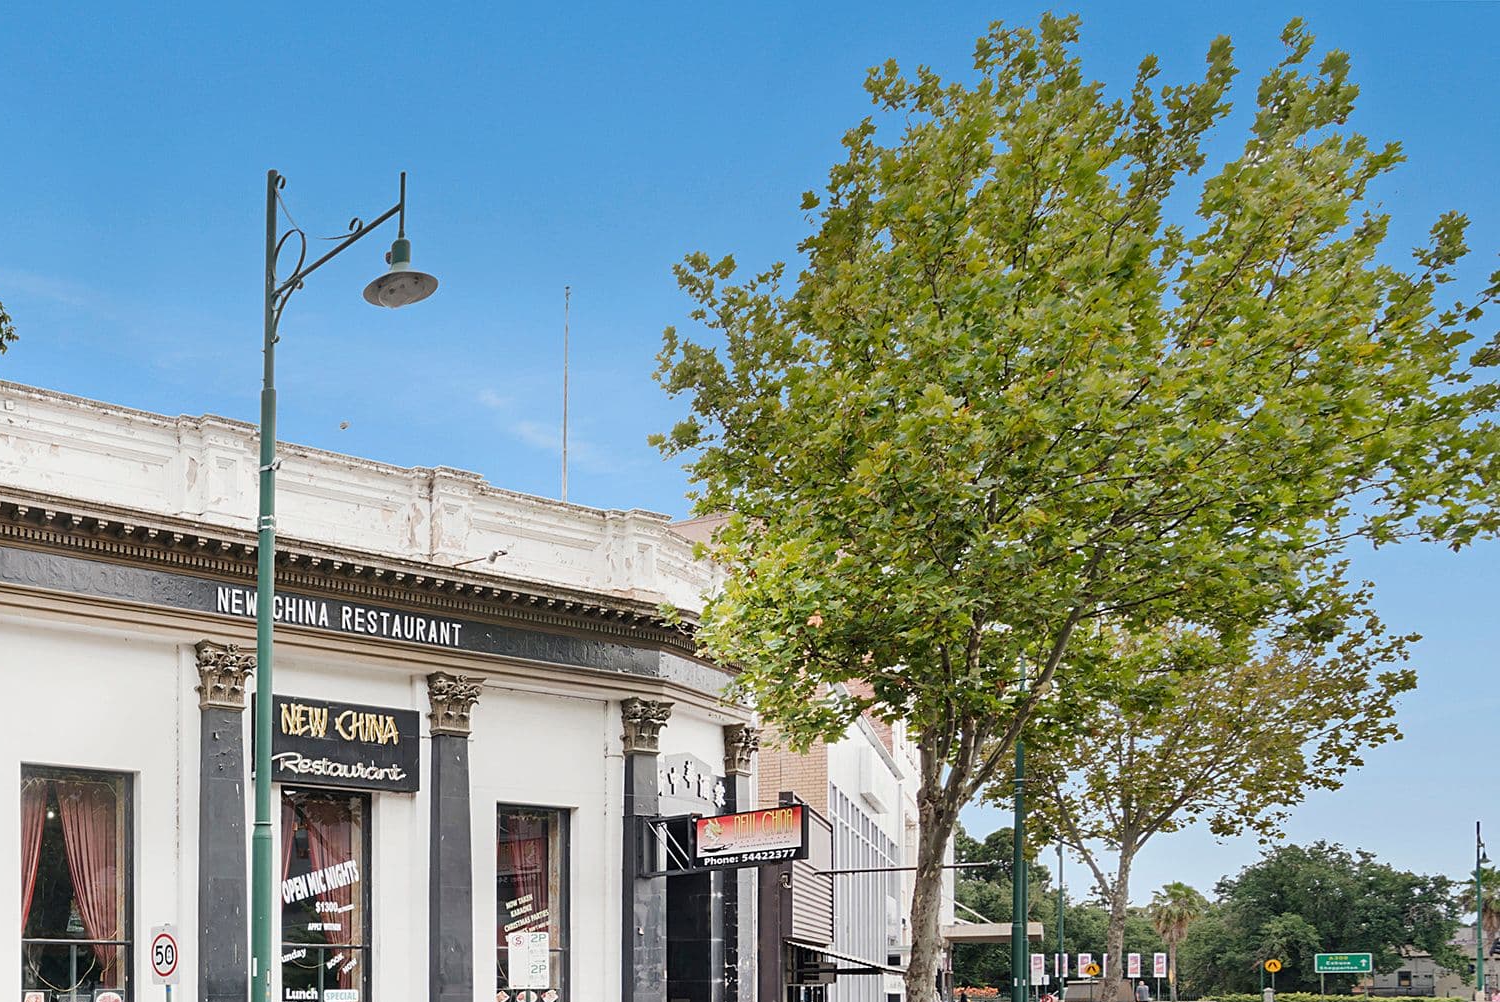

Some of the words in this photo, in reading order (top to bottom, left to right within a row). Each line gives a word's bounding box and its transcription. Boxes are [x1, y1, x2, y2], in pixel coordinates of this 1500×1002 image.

[217, 586, 258, 615] NEW
[273, 595, 329, 627] CHINA
[341, 605, 462, 646] RESTAURANT
[280, 703, 329, 738] NEW
[335, 710, 400, 745] CHINA
[271, 752, 407, 781] Restaurant
[734, 814, 756, 838] NEW
[762, 808, 793, 836] CHINA
[703, 855, 739, 866] Phone:
[741, 848, 797, 863] 54422377
[282, 874, 309, 904] OPEN
[306, 869, 327, 897] MIC
[324, 859, 360, 891] NIGHTS
[315, 901, 338, 914] $1300
[530, 933, 547, 942] 2P
[155, 944, 174, 965] 50
[280, 948, 307, 963] unday
[326, 952, 345, 970] BOOK
[342, 957, 358, 975] NOW
[530, 964, 547, 974] 2P
[285, 987, 318, 1000] Lunch
[325, 993, 357, 1001] SPECIAL
